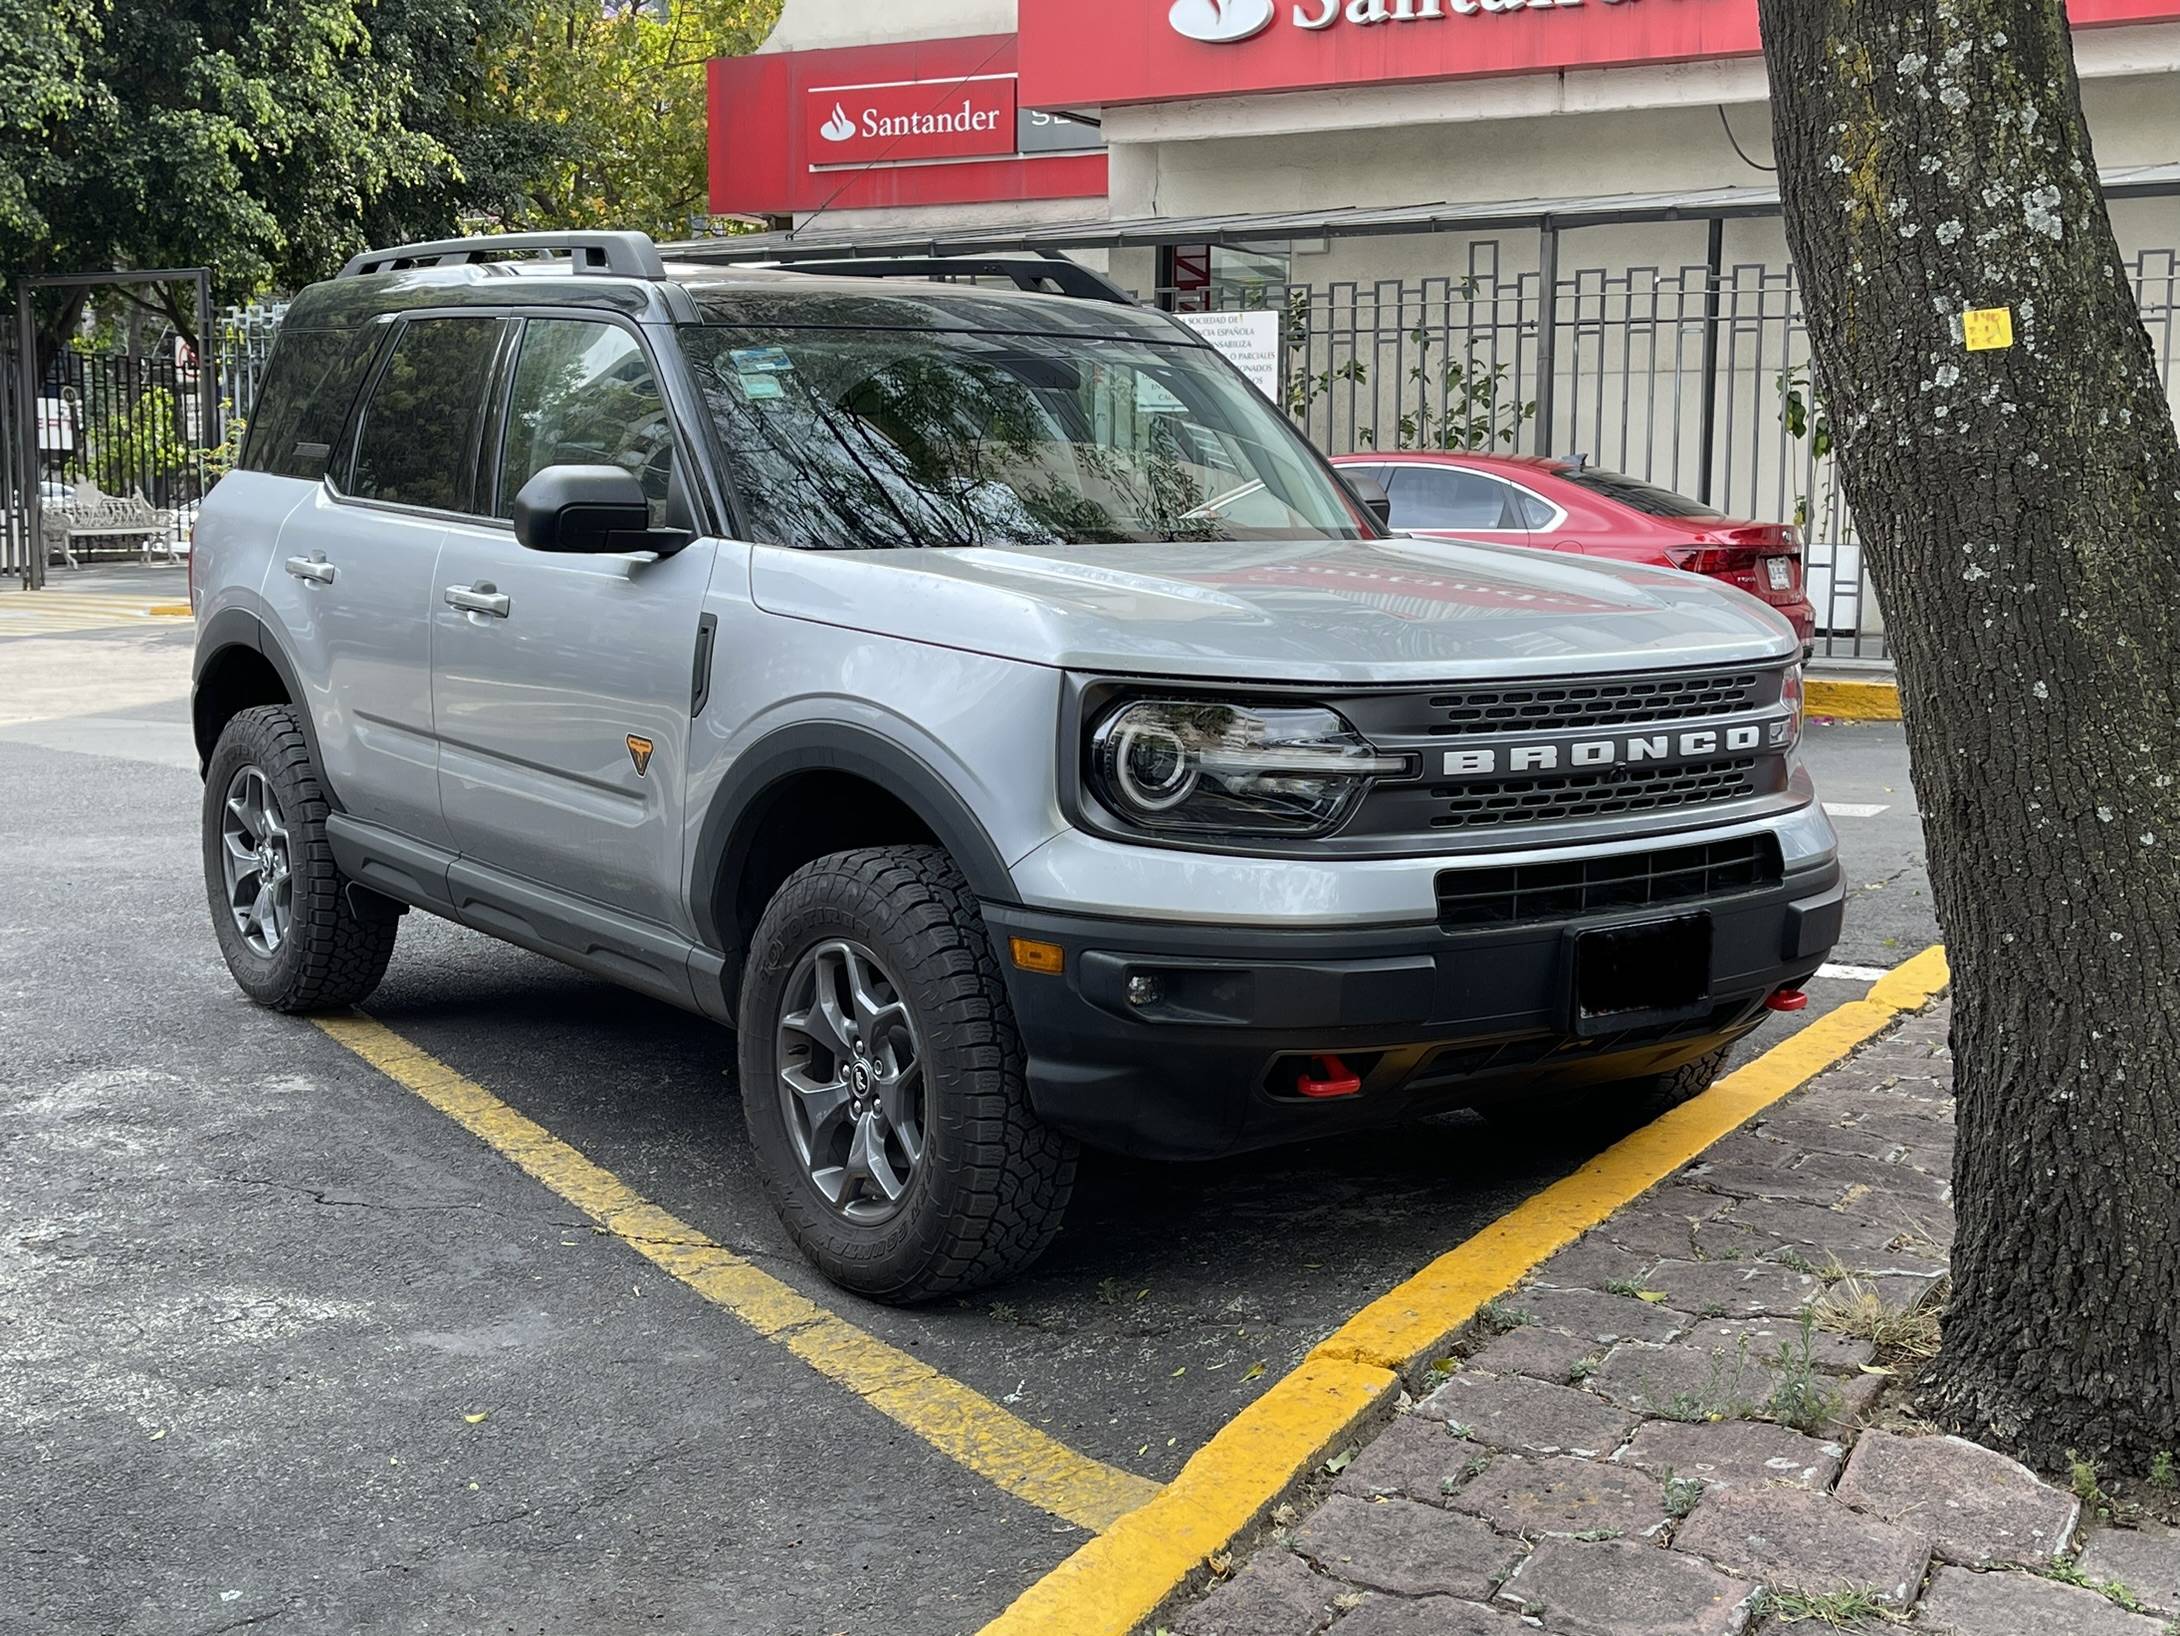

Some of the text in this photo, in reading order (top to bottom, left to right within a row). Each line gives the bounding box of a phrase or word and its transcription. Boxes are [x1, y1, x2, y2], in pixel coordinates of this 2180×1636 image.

[861, 100, 1000, 138] Santander
[1187, 316, 1227, 325] SOCIEDAD
[1217, 326, 1255, 337] ESPAÑOLA
[1238, 352, 1276, 360] PARCIALES
[1442, 725, 1761, 776] BRONCO
